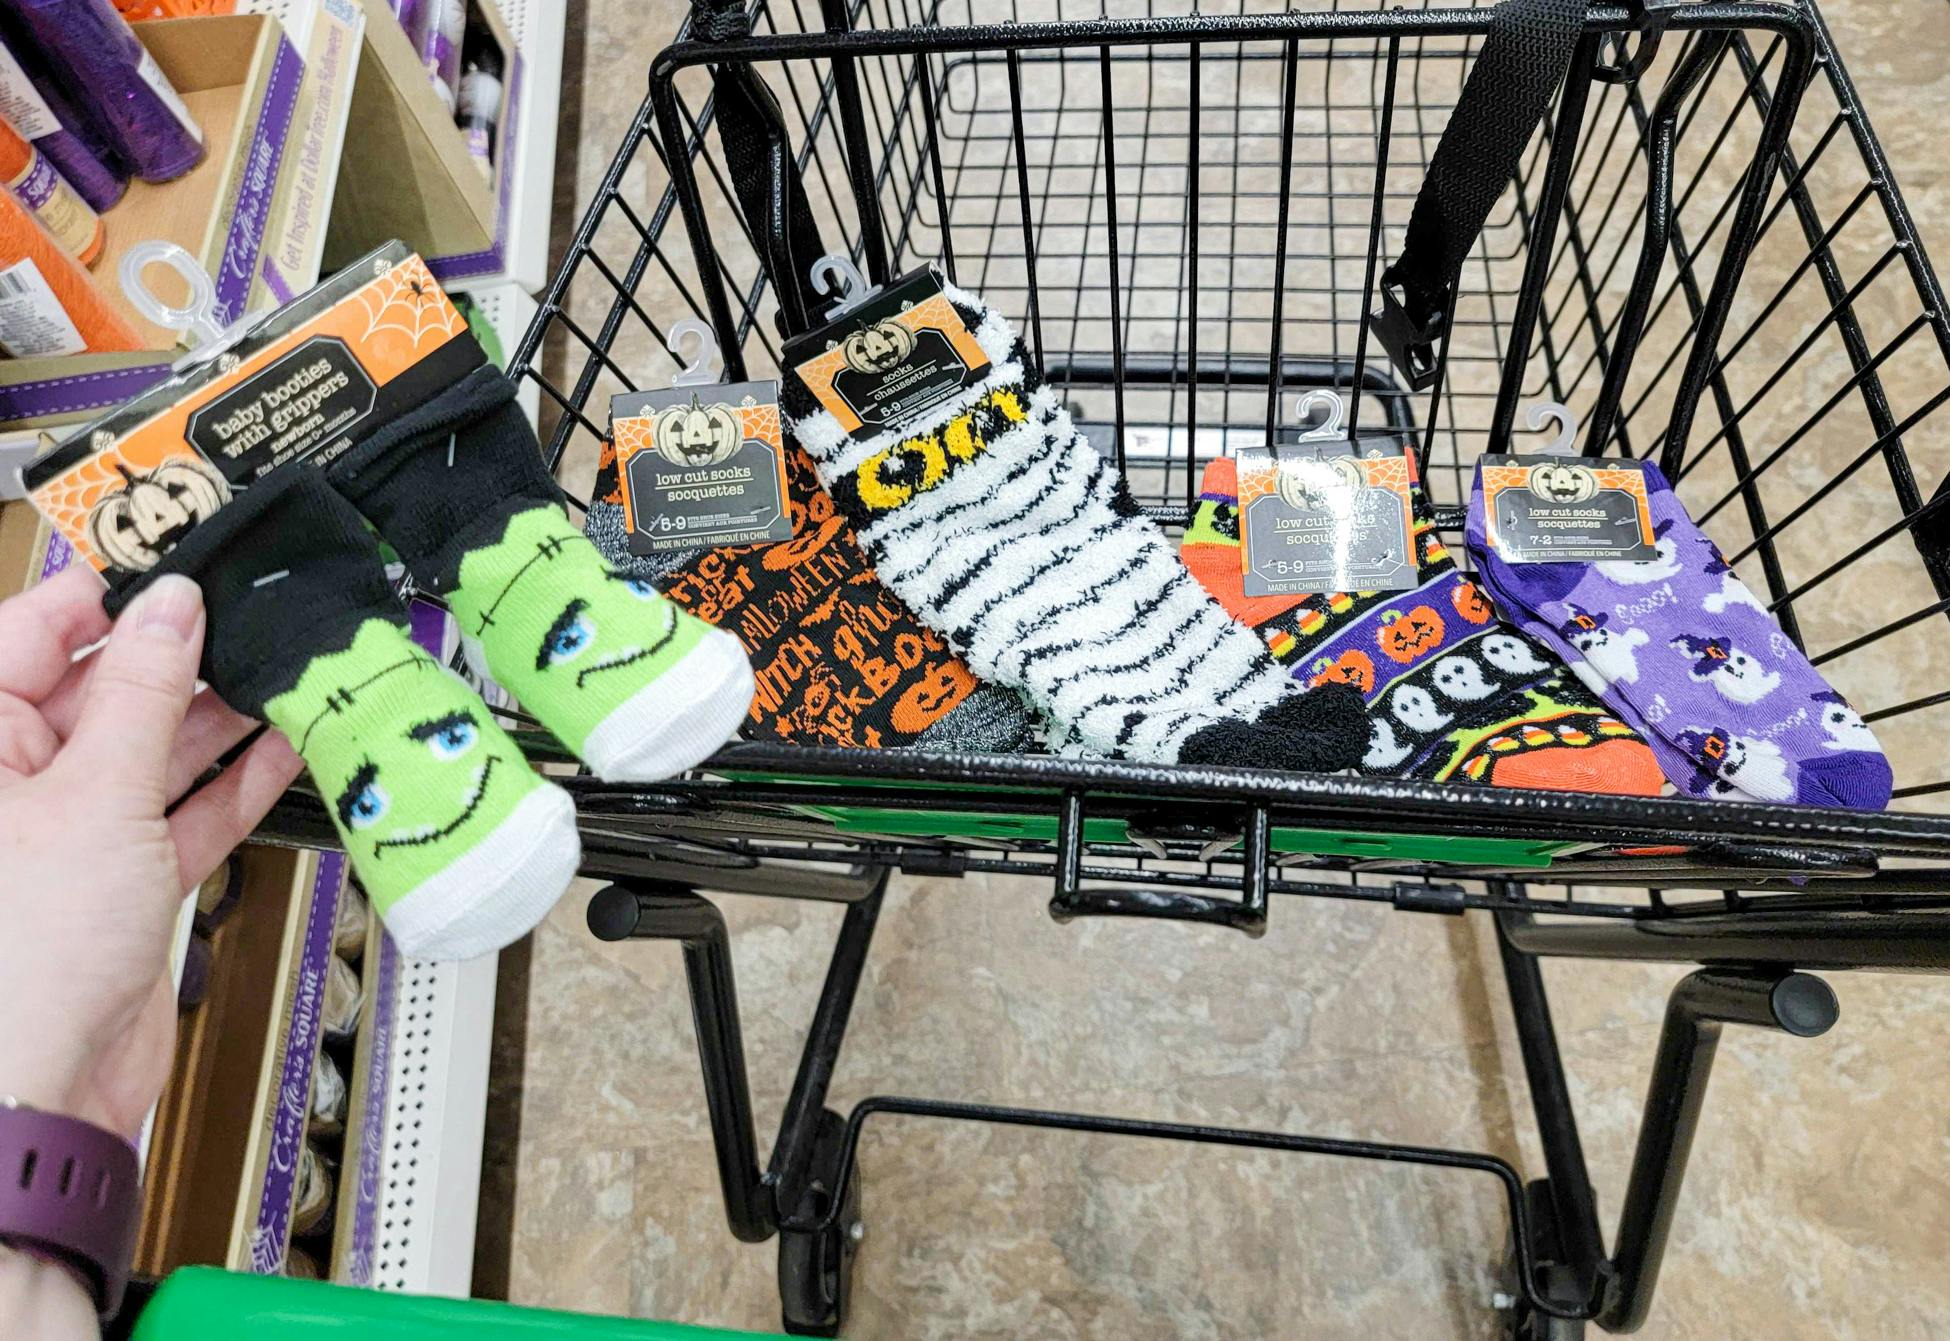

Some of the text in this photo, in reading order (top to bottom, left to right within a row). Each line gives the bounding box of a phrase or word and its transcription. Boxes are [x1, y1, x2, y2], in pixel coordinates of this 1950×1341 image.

[252, 141, 275, 199] SQUARE
[874, 365, 938, 401] chaussettes
[882, 363, 914, 384] socks
[212, 358, 333, 440] baby booties
[222, 371, 349, 459] with grippers
[270, 413, 325, 453] newborn
[324, 437, 353, 460] CHINA
[655, 466, 752, 486] low cut socks
[667, 484, 745, 502] socquettes
[1275, 518, 1302, 530] low
[1305, 515, 1330, 527] cut
[1528, 507, 1607, 518] low cut socks
[1537, 520, 1601, 530] socquettes
[652, 539, 673, 550] MADE
[673, 538, 682, 548] IN
[681, 537, 702, 548] CHINA
[740, 532, 750, 542] EN
[749, 530, 771, 541] CHINE
[1529, 535, 1552, 545] 7-2
[1267, 583, 1289, 593] MADE
[1289, 582, 1297, 592] IN
[1298, 581, 1321, 591] CHINA
[1360, 578, 1371, 587] EN
[1371, 577, 1394, 587] CHINE
[273, 968, 320, 1174] Crafter's SQUARE
